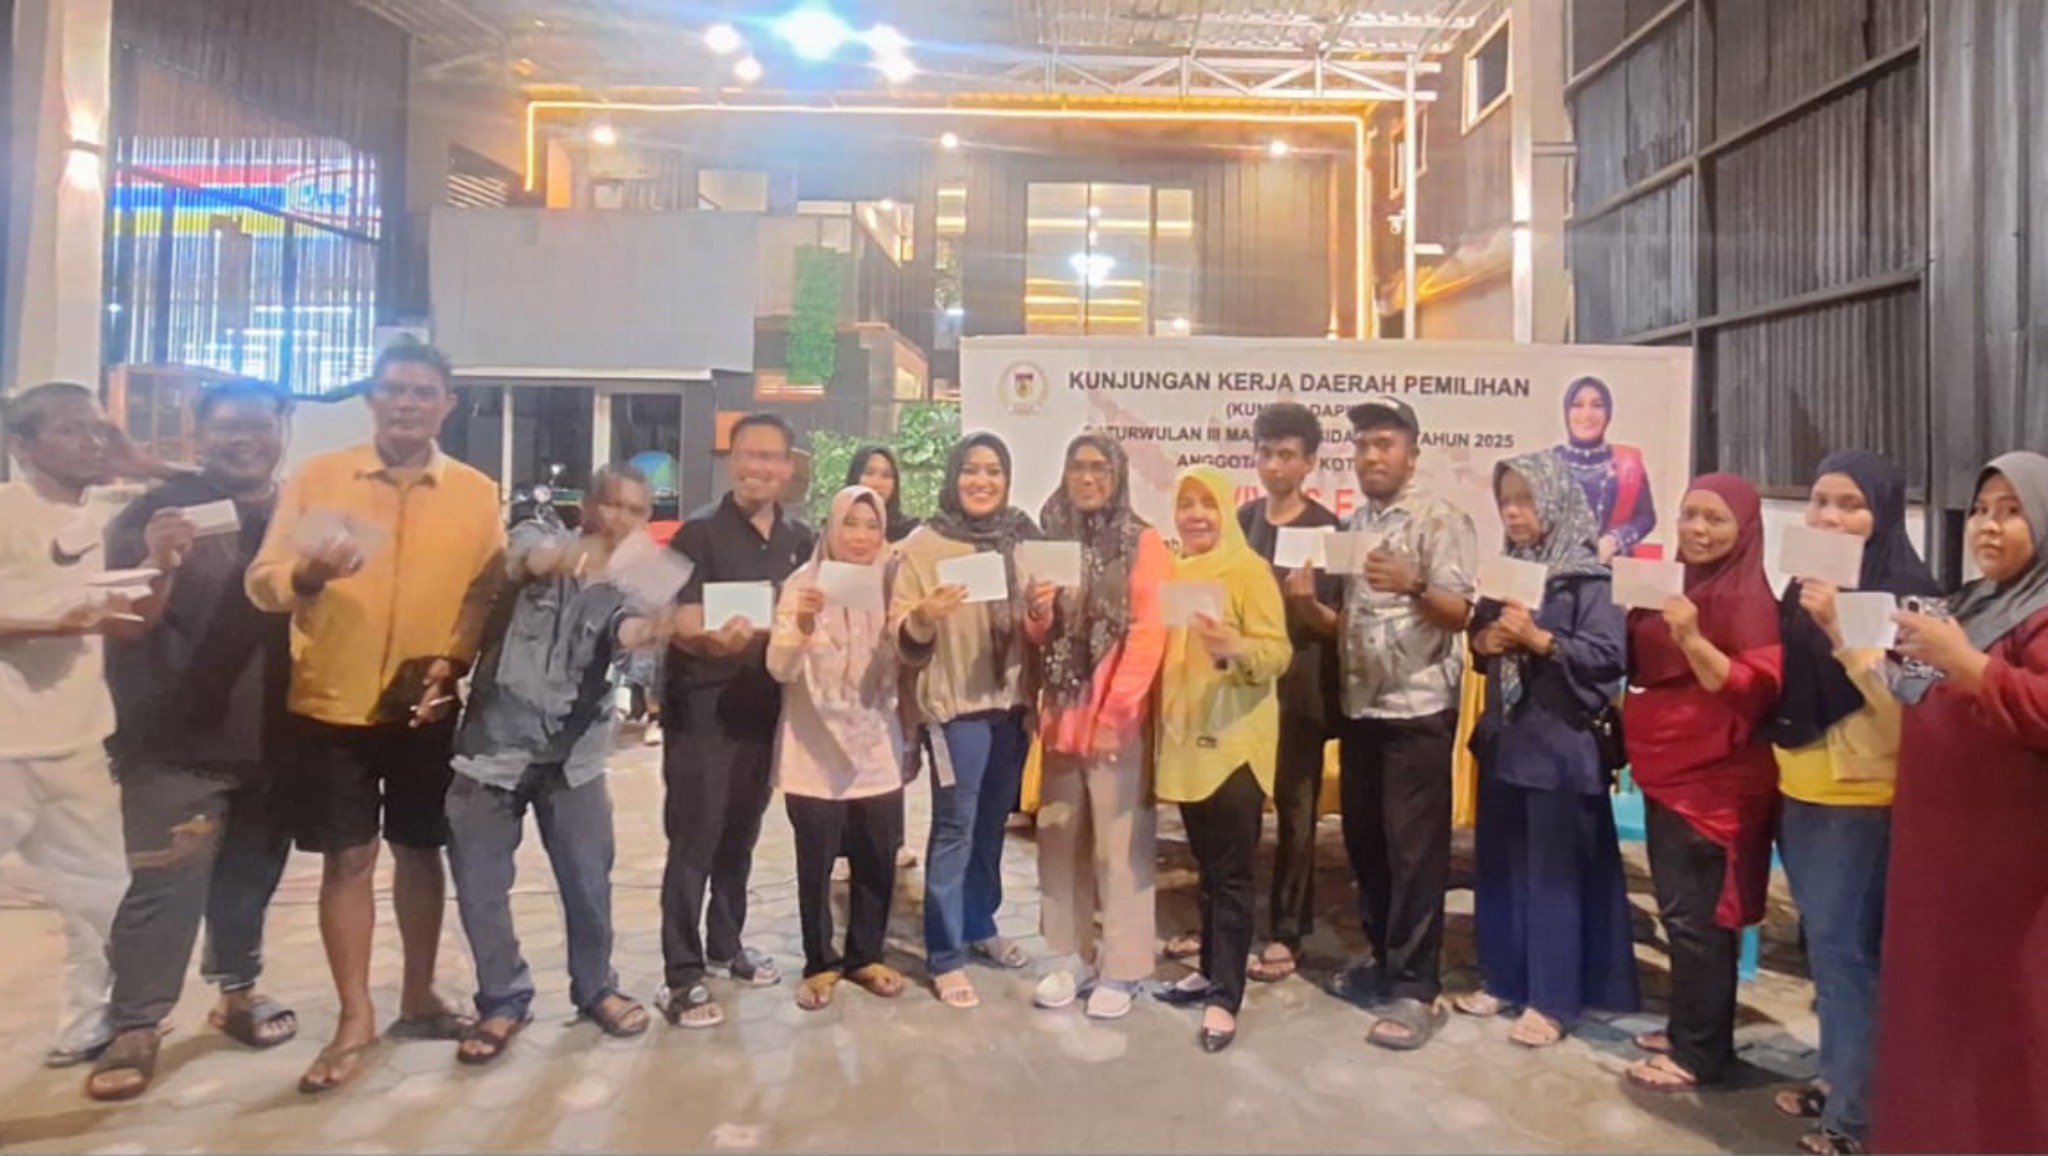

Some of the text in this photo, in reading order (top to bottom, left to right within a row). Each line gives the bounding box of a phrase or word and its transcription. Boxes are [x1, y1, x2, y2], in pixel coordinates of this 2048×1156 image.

[1069, 371, 1529, 397] KUNJUNGAN KERJA DAERAH PEMILIHAN
[1420, 432, 1469, 447] AHUN
[1474, 434, 1515, 449] 2025
[1319, 458, 1355, 472] KOT
